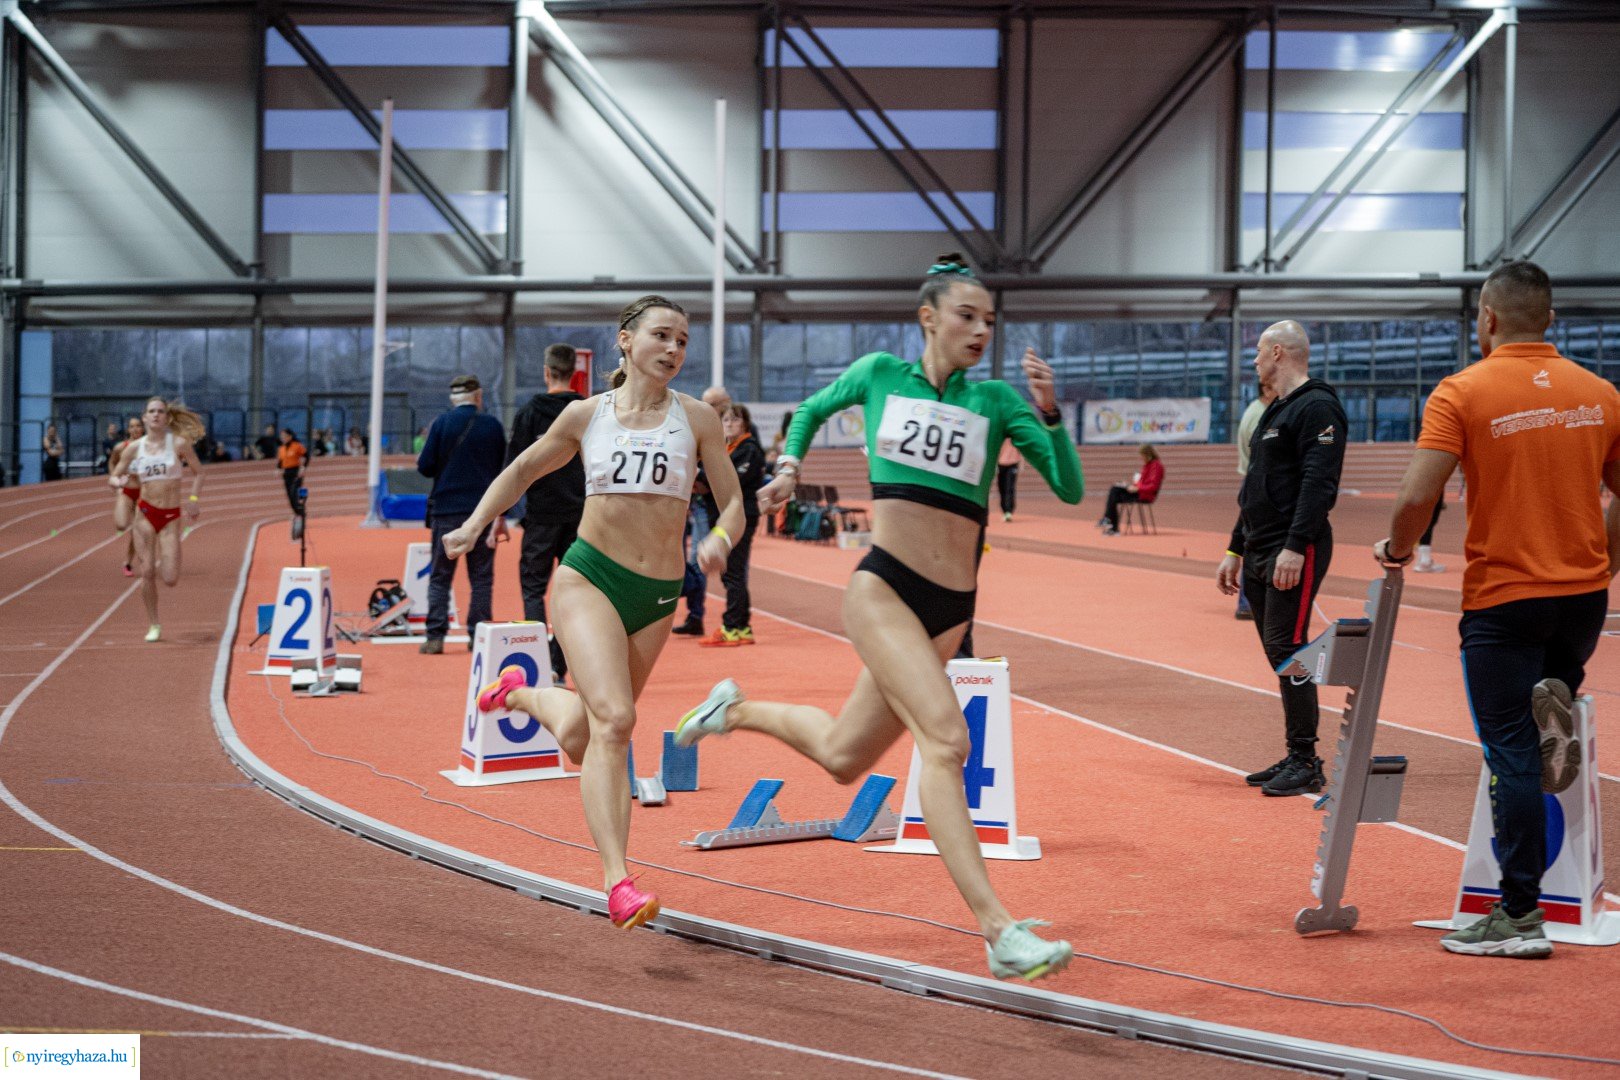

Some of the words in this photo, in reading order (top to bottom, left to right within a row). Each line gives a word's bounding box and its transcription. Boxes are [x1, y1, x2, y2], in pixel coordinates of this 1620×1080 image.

[1490, 404, 1604, 438] VERSENYBÍRÓ
[899, 420, 966, 468] 295
[611, 450, 669, 485] 276
[279, 588, 313, 650] 2
[322, 587, 333, 650] 2
[510, 634, 541, 645] polanik
[496, 652, 542, 744] 3
[954, 675, 994, 686] polanik
